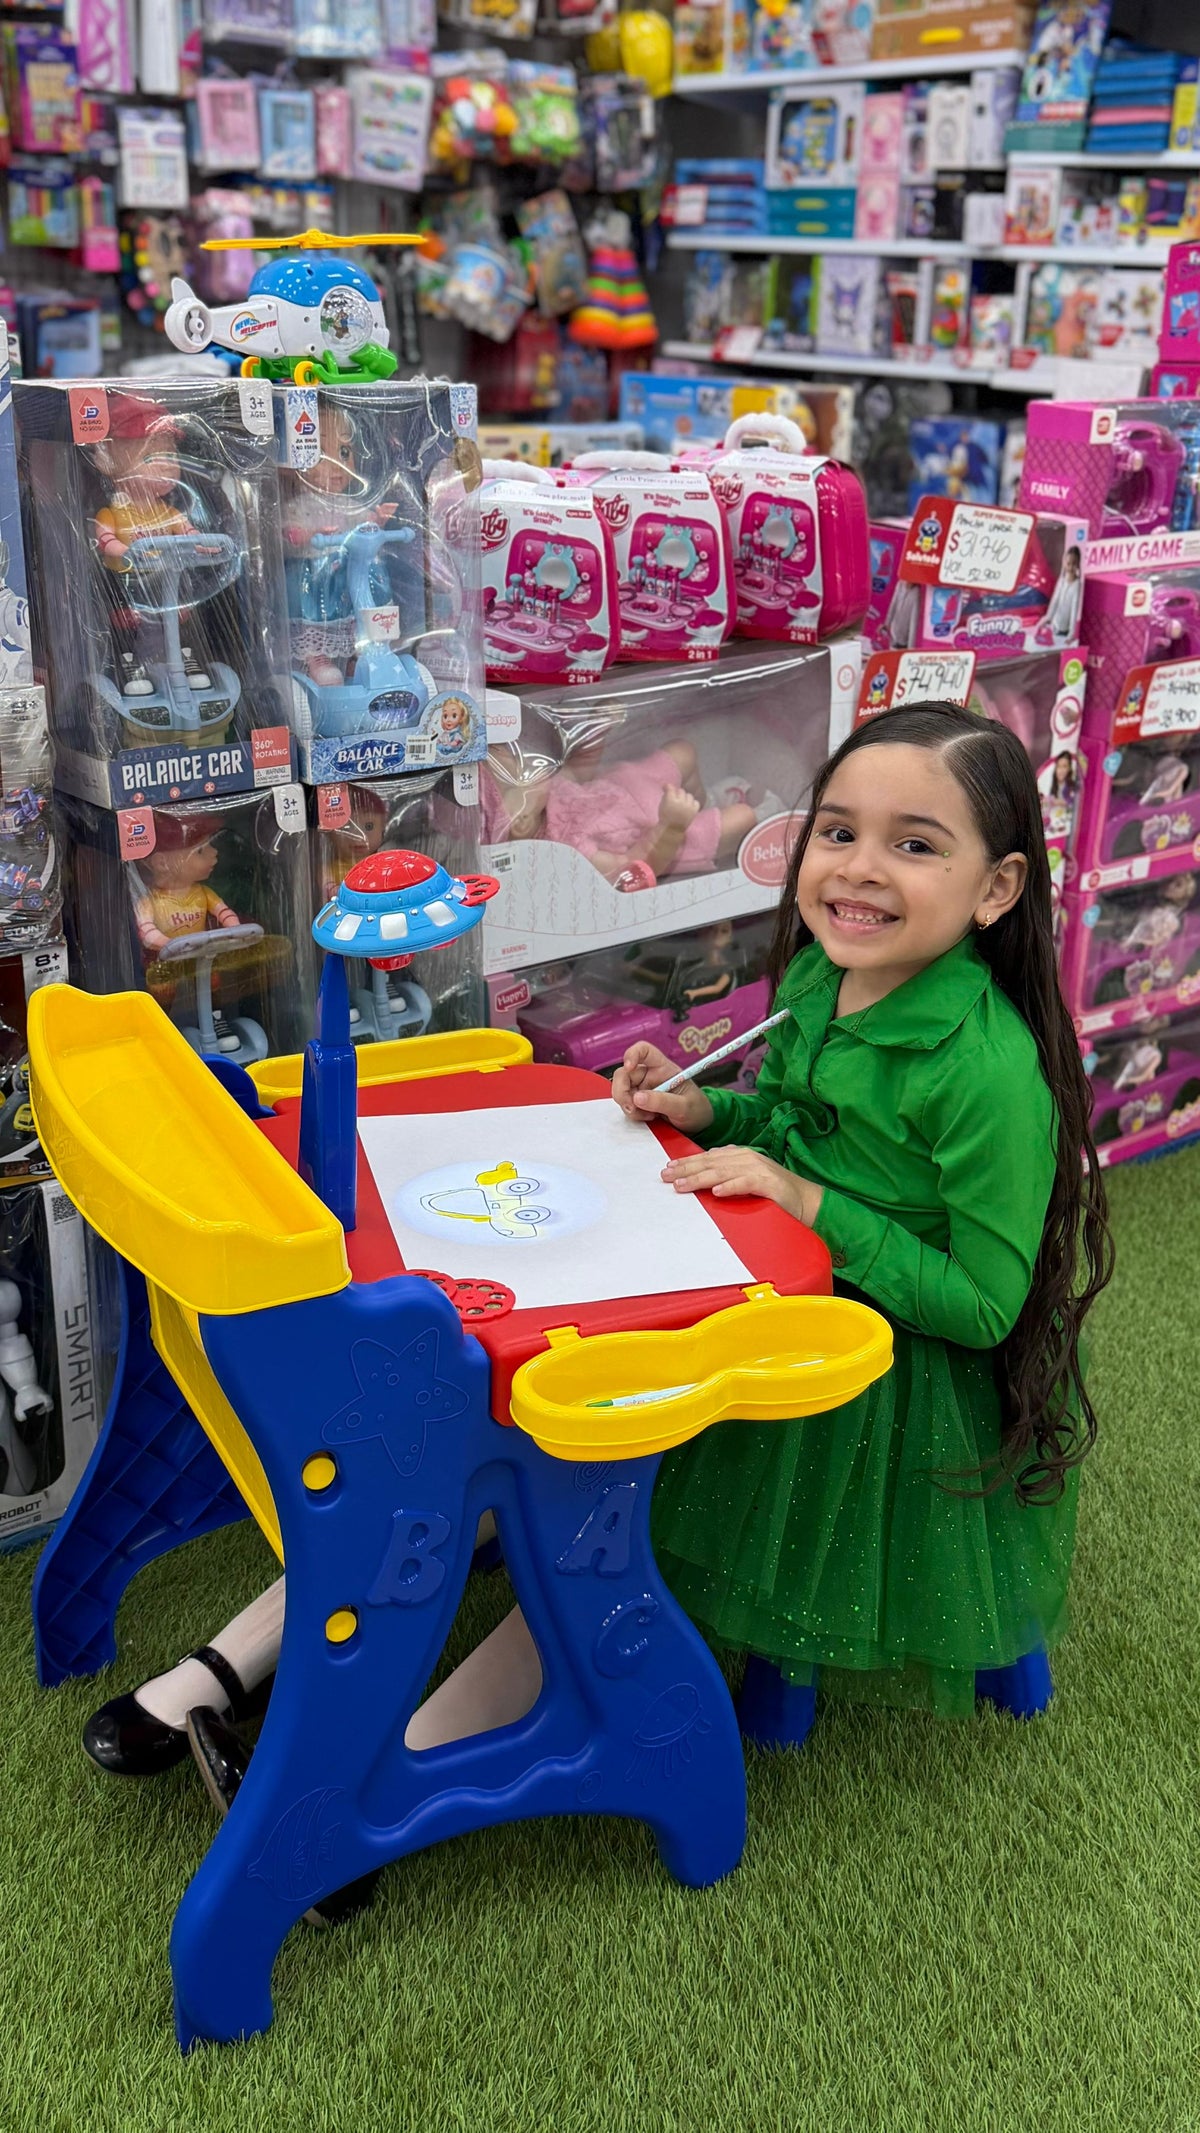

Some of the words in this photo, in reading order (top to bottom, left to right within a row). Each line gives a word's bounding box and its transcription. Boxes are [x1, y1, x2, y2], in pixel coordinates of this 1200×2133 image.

[235, 317, 251, 332] NEW
[240, 320, 277, 335] HELICOPTER
[250, 396, 264, 410] 3+
[1031, 481, 1069, 500] FAMILY
[1137, 538, 1184, 561] GAME
[970, 618, 1012, 636] Funny
[790, 631, 796, 641] 2
[799, 632, 806, 641] in
[688, 651, 695, 659] 2
[695, 651, 705, 659] in
[568, 674, 576, 684] 2
[577, 674, 587, 684] in
[255, 749, 289, 760] ROTATING
[337, 743, 399, 763] BALANCE
[122, 754, 203, 790] BALANCE
[207, 749, 245, 778] CAR
[357, 758, 384, 773] CAR
[460, 772, 473, 784] 3+
[283, 798, 298, 810] 3+
[283, 809, 300, 817] AGES
[35, 952, 60, 967] 8+
[37, 965, 60, 975] AGES
[29, 1160, 51, 1172] STU
[64, 1303, 95, 1422] SMART
[0, 1500, 42, 1521] ROBOT
[554, 1483, 639, 1578] A
[365, 1508, 451, 1608] B
